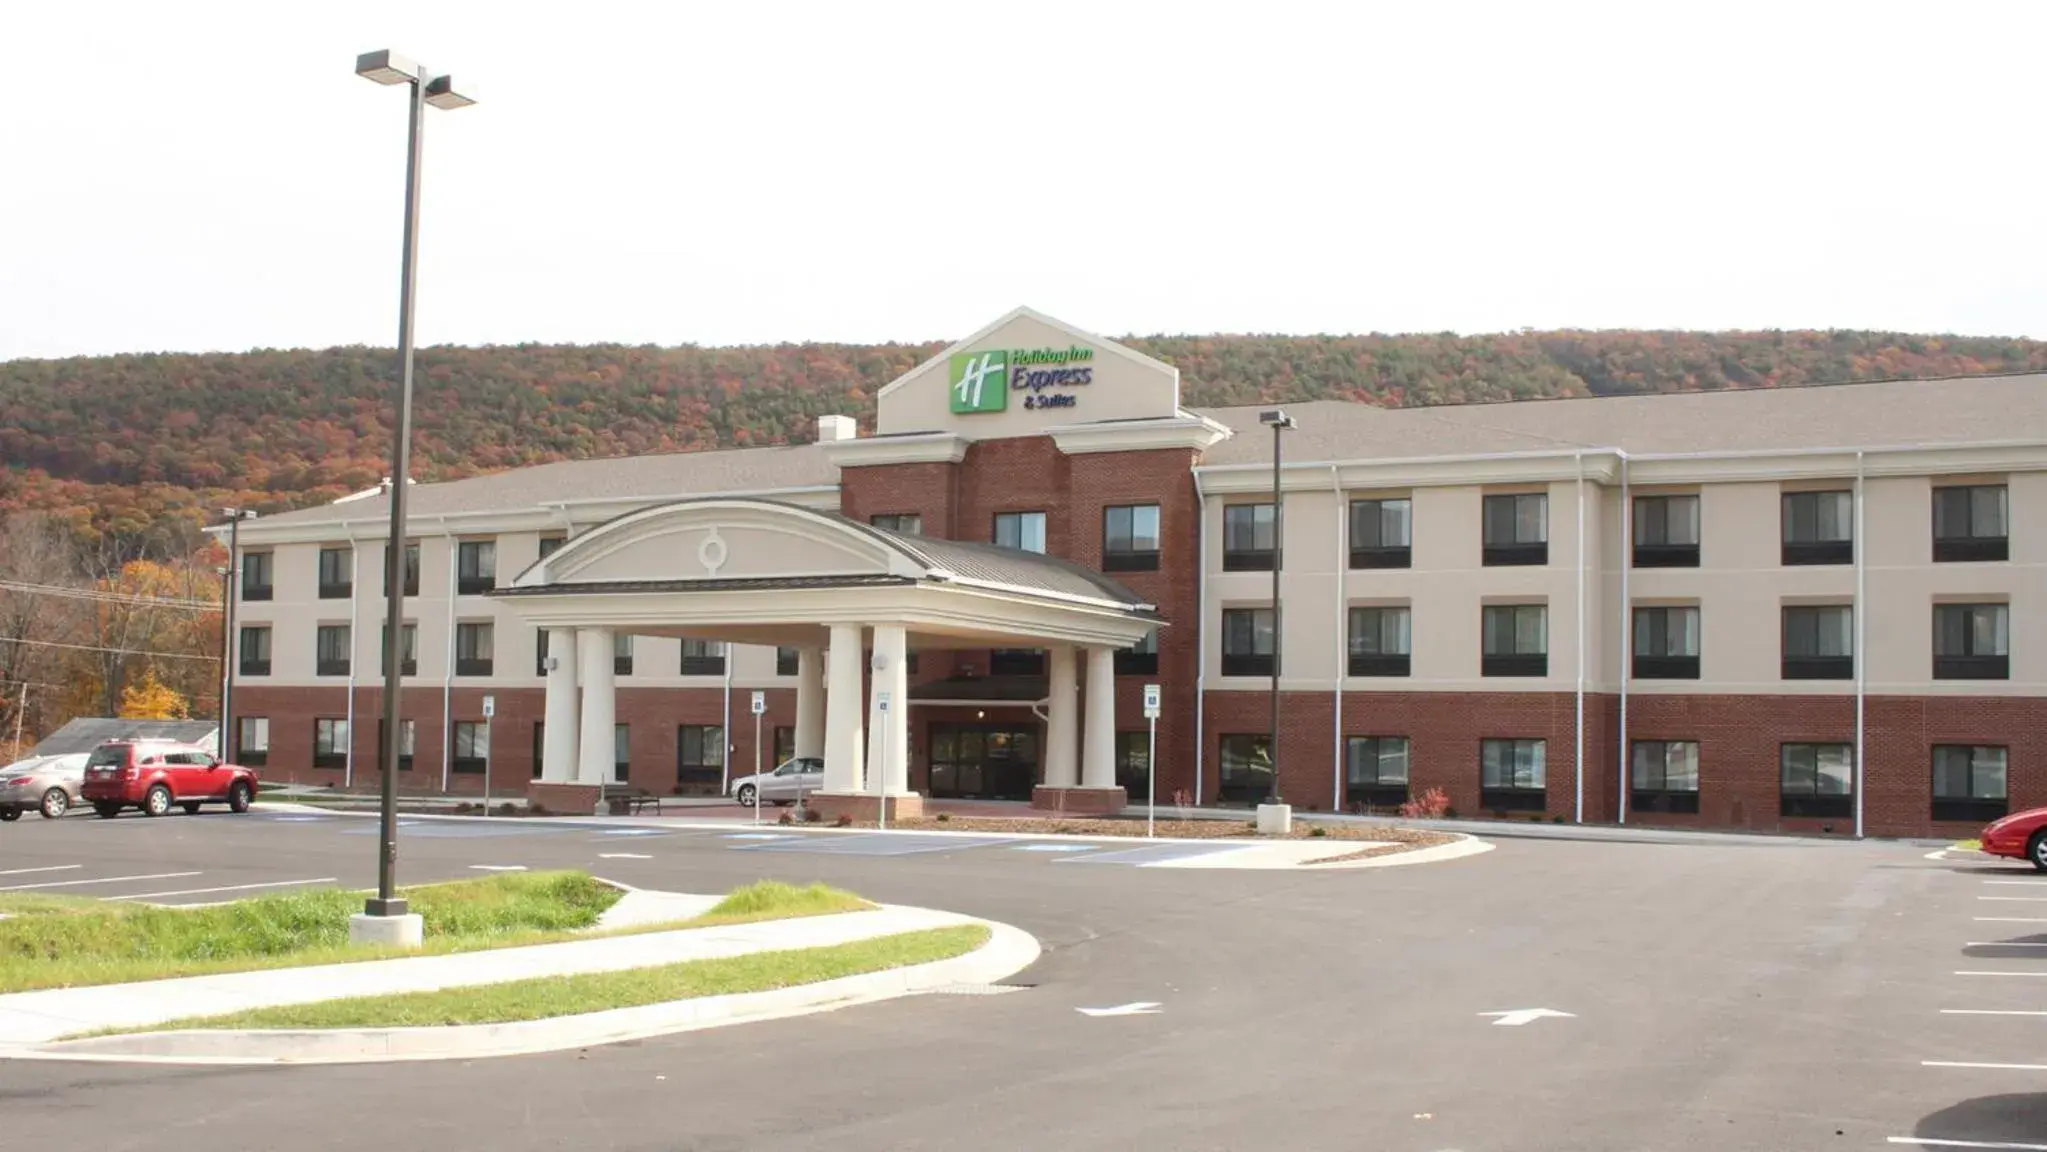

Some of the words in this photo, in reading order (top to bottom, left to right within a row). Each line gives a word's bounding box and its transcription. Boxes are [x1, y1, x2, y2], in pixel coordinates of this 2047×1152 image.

[1013, 347, 1069, 365] Holiday
[1070, 345, 1093, 361] Inn
[1012, 367, 1092, 392] Express
[1024, 395, 1034, 410] &
[1037, 394, 1076, 409] Suites
